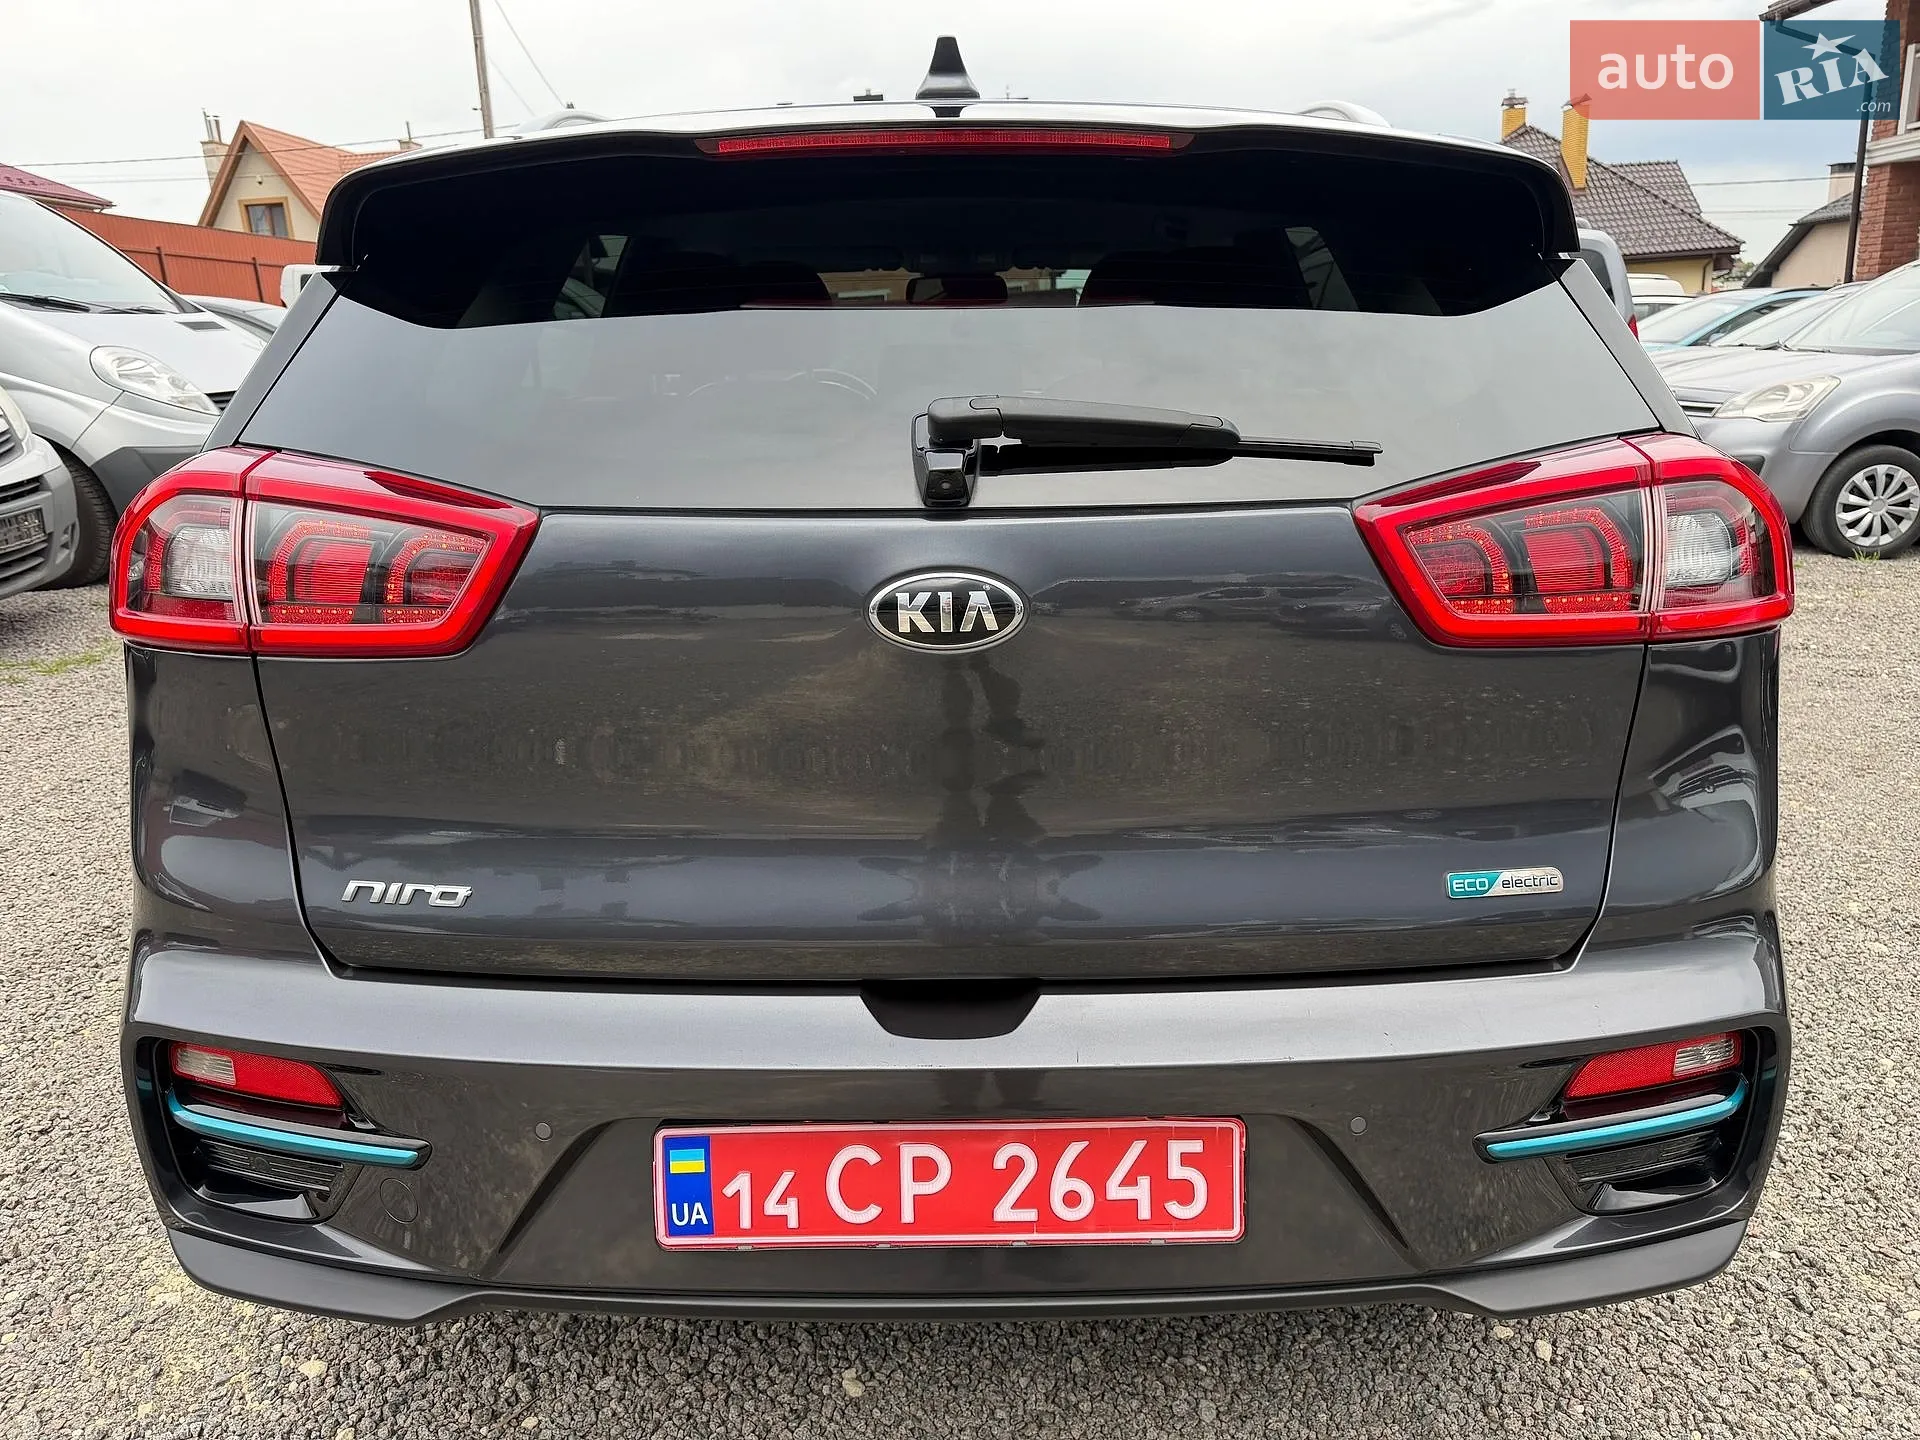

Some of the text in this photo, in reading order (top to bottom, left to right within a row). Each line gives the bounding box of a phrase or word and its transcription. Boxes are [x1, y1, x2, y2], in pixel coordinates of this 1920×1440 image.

[895, 591, 999, 633] KIA
[341, 879, 472, 908] niro
[1452, 874, 1558, 892] ECO electric
[722, 1140, 1208, 1229] 14 CP 2645
[671, 1203, 709, 1226] UA
